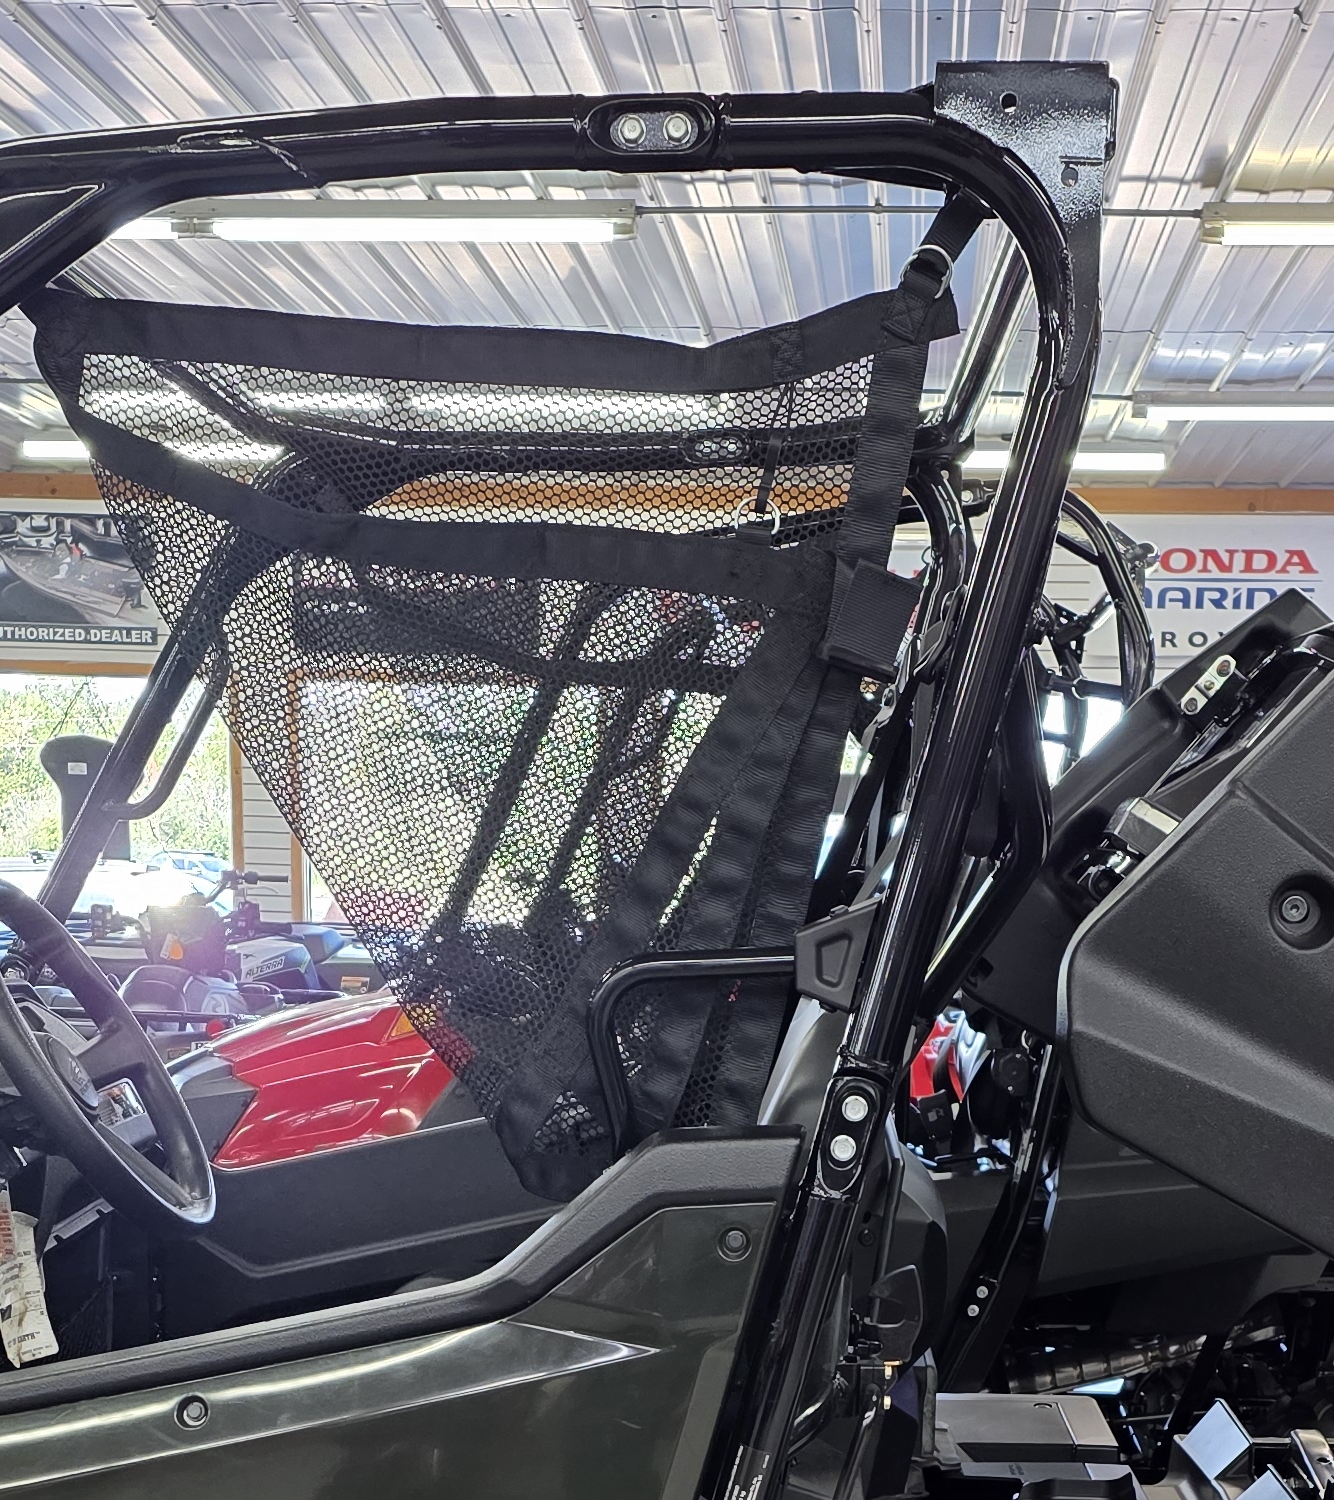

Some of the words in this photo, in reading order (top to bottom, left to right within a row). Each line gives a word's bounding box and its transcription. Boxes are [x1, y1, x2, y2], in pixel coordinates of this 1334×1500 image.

[1155, 547, 1319, 575] ONDA
[90, 628, 153, 643] DEALER
[245, 957, 285, 979] ALTERRA
